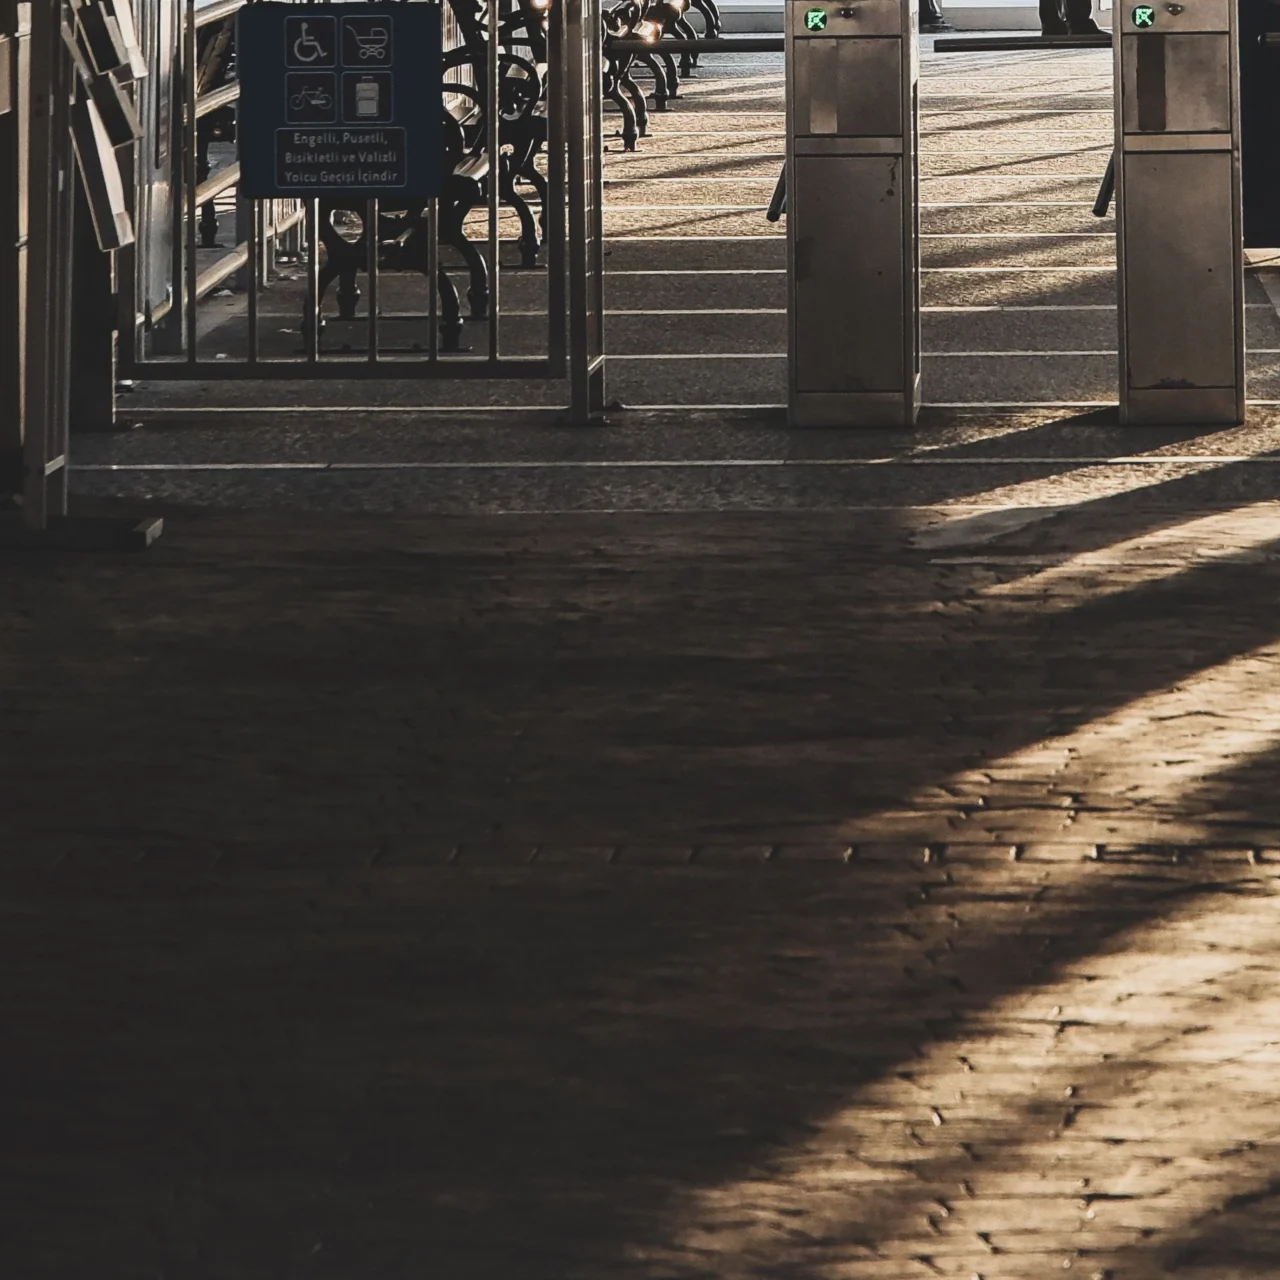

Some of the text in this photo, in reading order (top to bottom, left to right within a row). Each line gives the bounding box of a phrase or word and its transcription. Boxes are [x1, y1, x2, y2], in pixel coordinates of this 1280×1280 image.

[293, 132, 389, 148] Engelli, Pusetli,
[284, 151, 397, 164] Bisikletli ve Valizli
[284, 170, 318, 183] Yolcu
